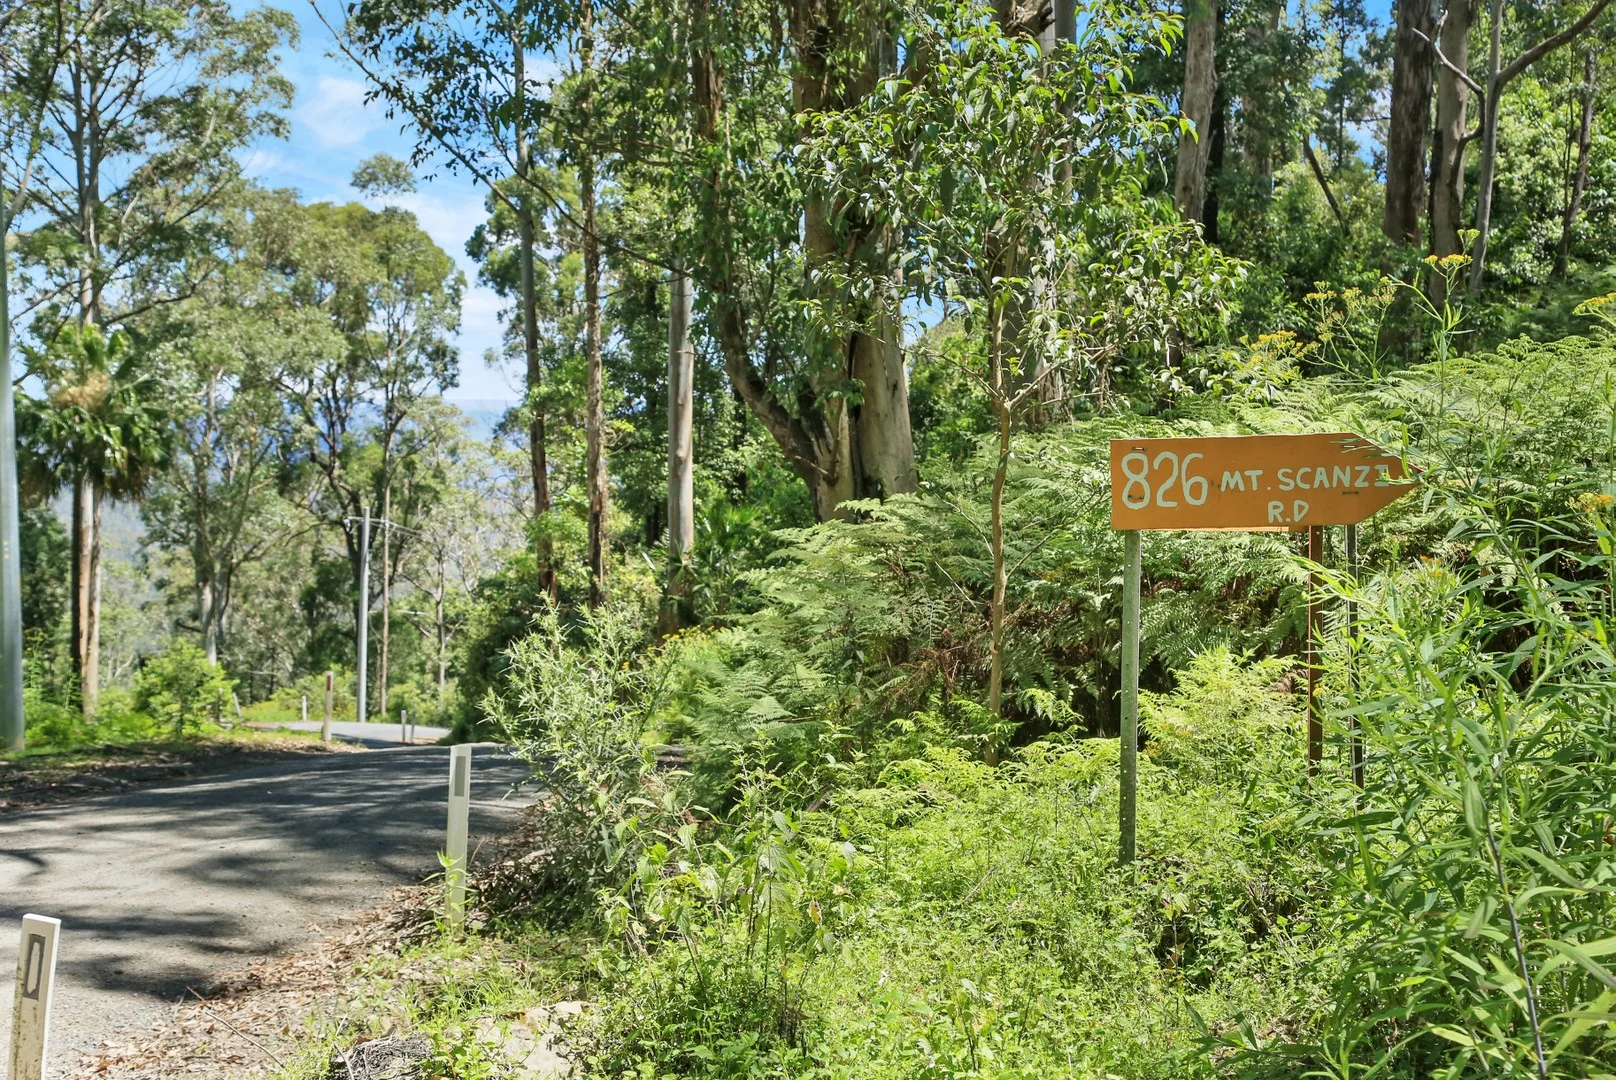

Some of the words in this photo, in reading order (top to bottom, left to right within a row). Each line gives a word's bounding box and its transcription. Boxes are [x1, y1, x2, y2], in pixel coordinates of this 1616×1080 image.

[1121, 451, 1208, 509] 826
[1220, 469, 1272, 492] MT.
[1277, 464, 1389, 490] SCANZI
[1267, 499, 1310, 523] R.D
